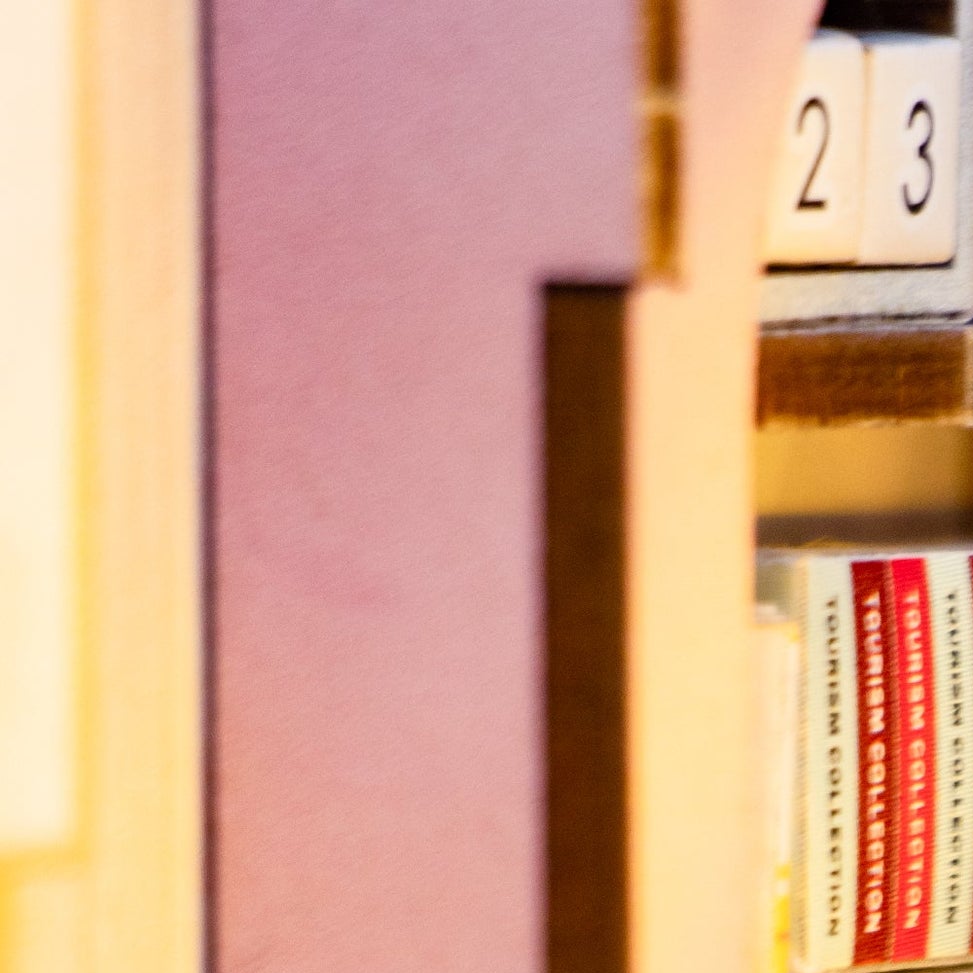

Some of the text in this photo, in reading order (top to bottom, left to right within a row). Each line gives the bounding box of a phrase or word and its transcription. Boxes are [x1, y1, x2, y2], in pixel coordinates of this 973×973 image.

[796, 98, 934, 215] 2 3
[826, 598, 843, 937] TOURISM COLLECTION
[863, 591, 886, 934] TOURISM COLLECTION
[903, 589, 926, 930] TOURISM COLLECTION
[945, 589, 965, 925] TOURISM COLLECTION
